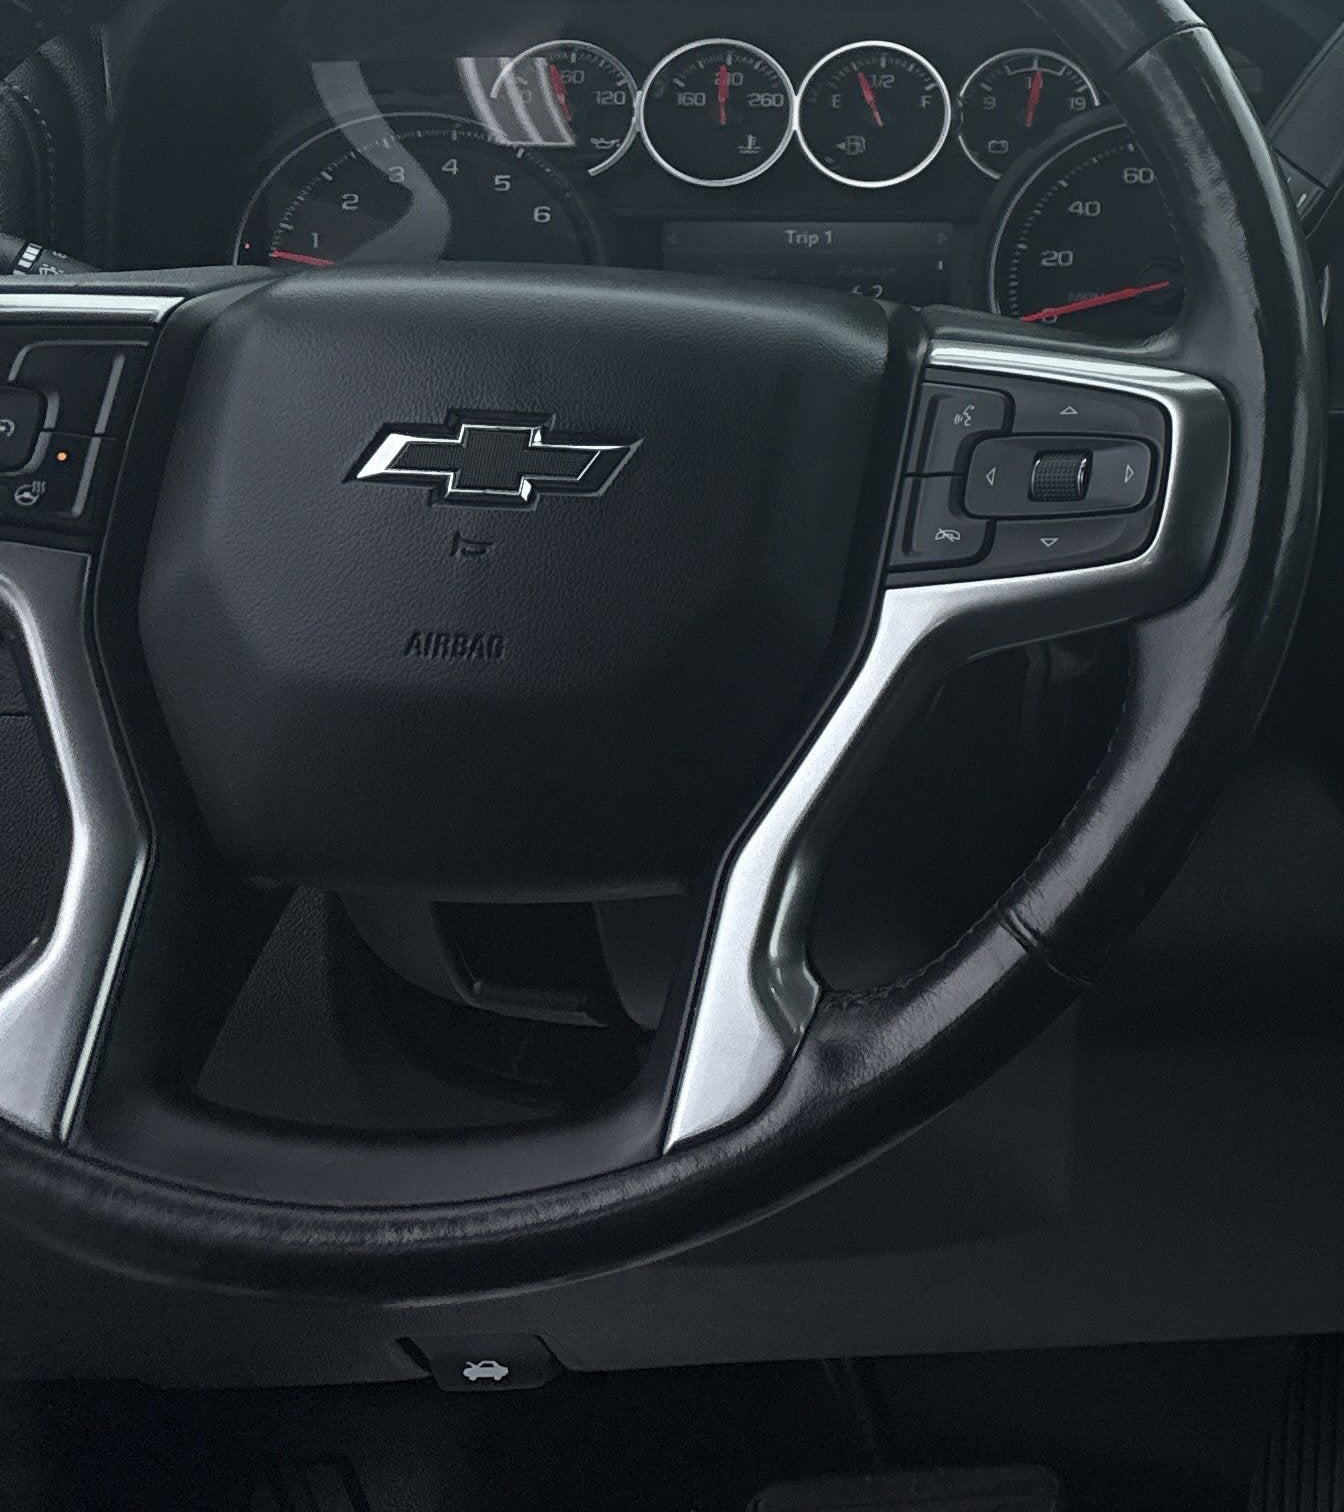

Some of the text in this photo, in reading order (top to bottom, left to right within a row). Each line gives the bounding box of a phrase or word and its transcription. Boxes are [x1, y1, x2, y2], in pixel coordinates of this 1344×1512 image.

[594, 90, 627, 105] 120
[676, 91, 707, 107] 160
[748, 92, 785, 107] 260
[831, 93, 843, 108] E
[920, 94, 932, 108] F
[983, 96, 997, 110] 9
[1069, 96, 1087, 111] 19
[388, 166, 406, 184] 3
[441, 158, 459, 175] 4
[493, 174, 512, 192] 5
[1123, 167, 1155, 184] 60
[341, 193, 360, 211] 2
[1068, 200, 1101, 218] 40
[533, 205, 552, 224] 6
[311, 232, 320, 249] 1
[784, 229, 833, 248] Trip 1
[1041, 249, 1075, 267] 20
[403, 630, 504, 661] AIRBAG
